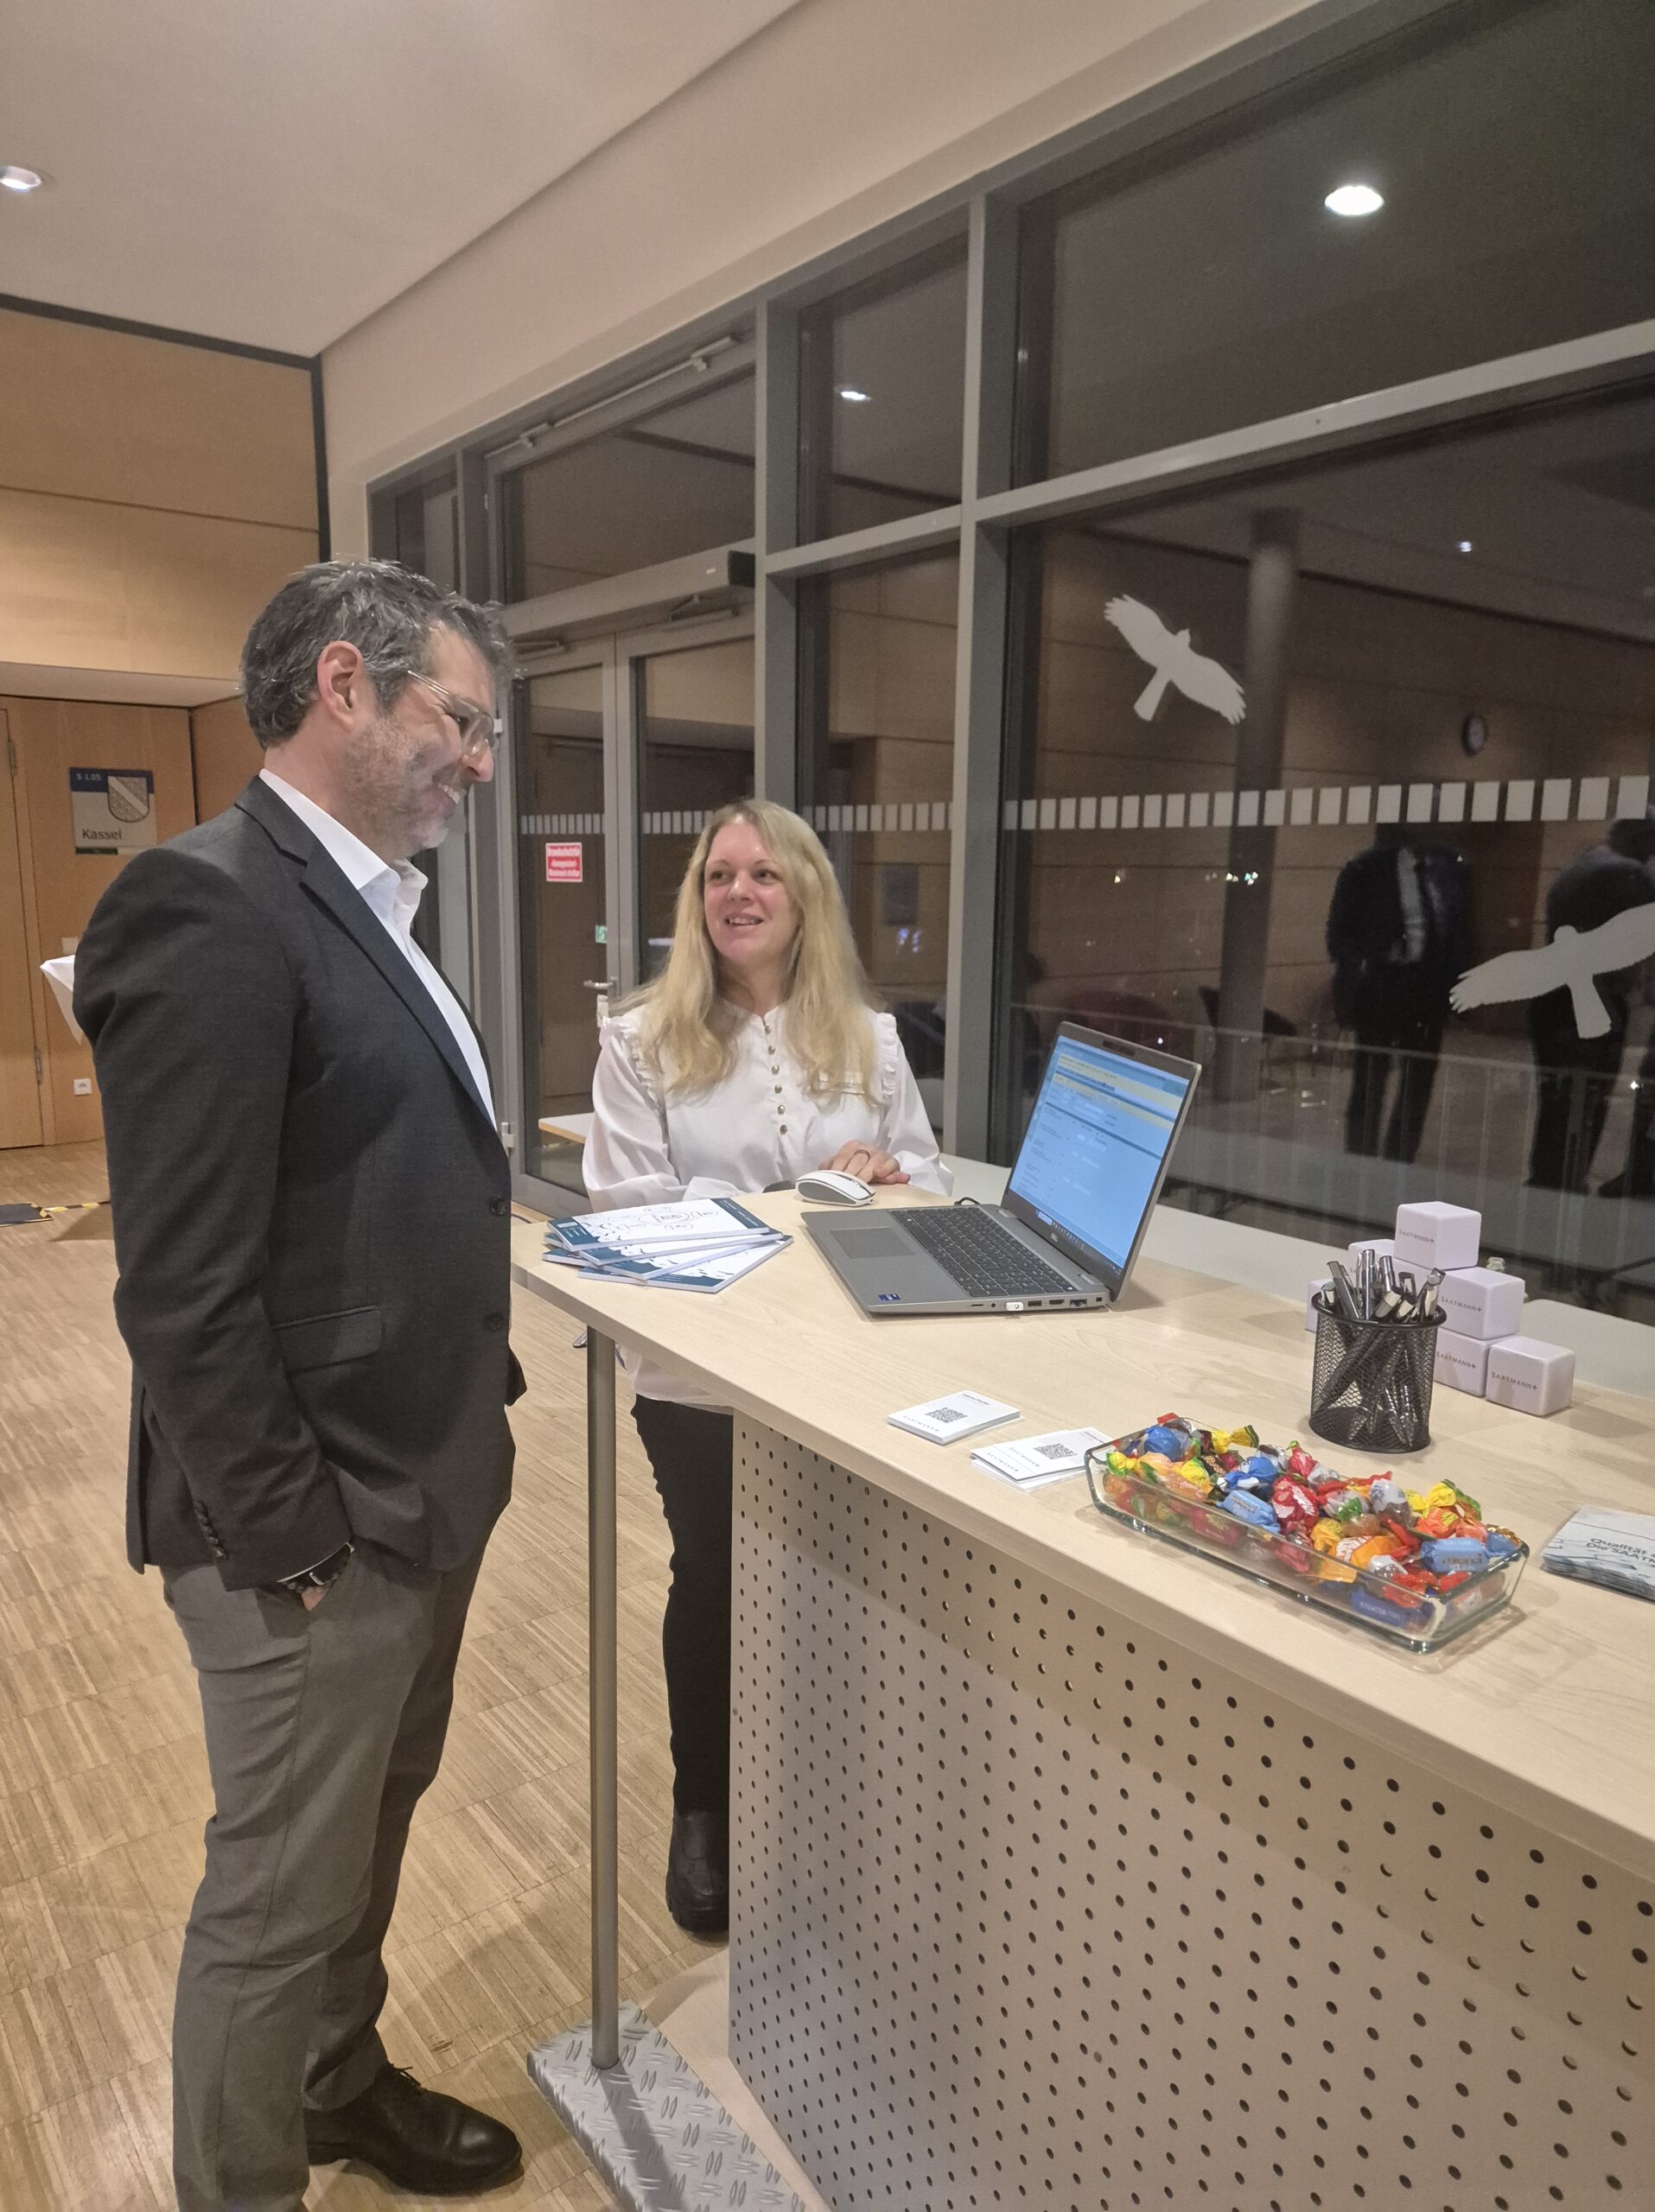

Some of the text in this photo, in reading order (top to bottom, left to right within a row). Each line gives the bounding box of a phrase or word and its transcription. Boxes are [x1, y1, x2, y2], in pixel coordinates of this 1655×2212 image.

[82, 828, 122, 840] Kassel
[1491, 1371, 1531, 1389] SAATMANN
[1586, 1542, 1608, 1551] Die
